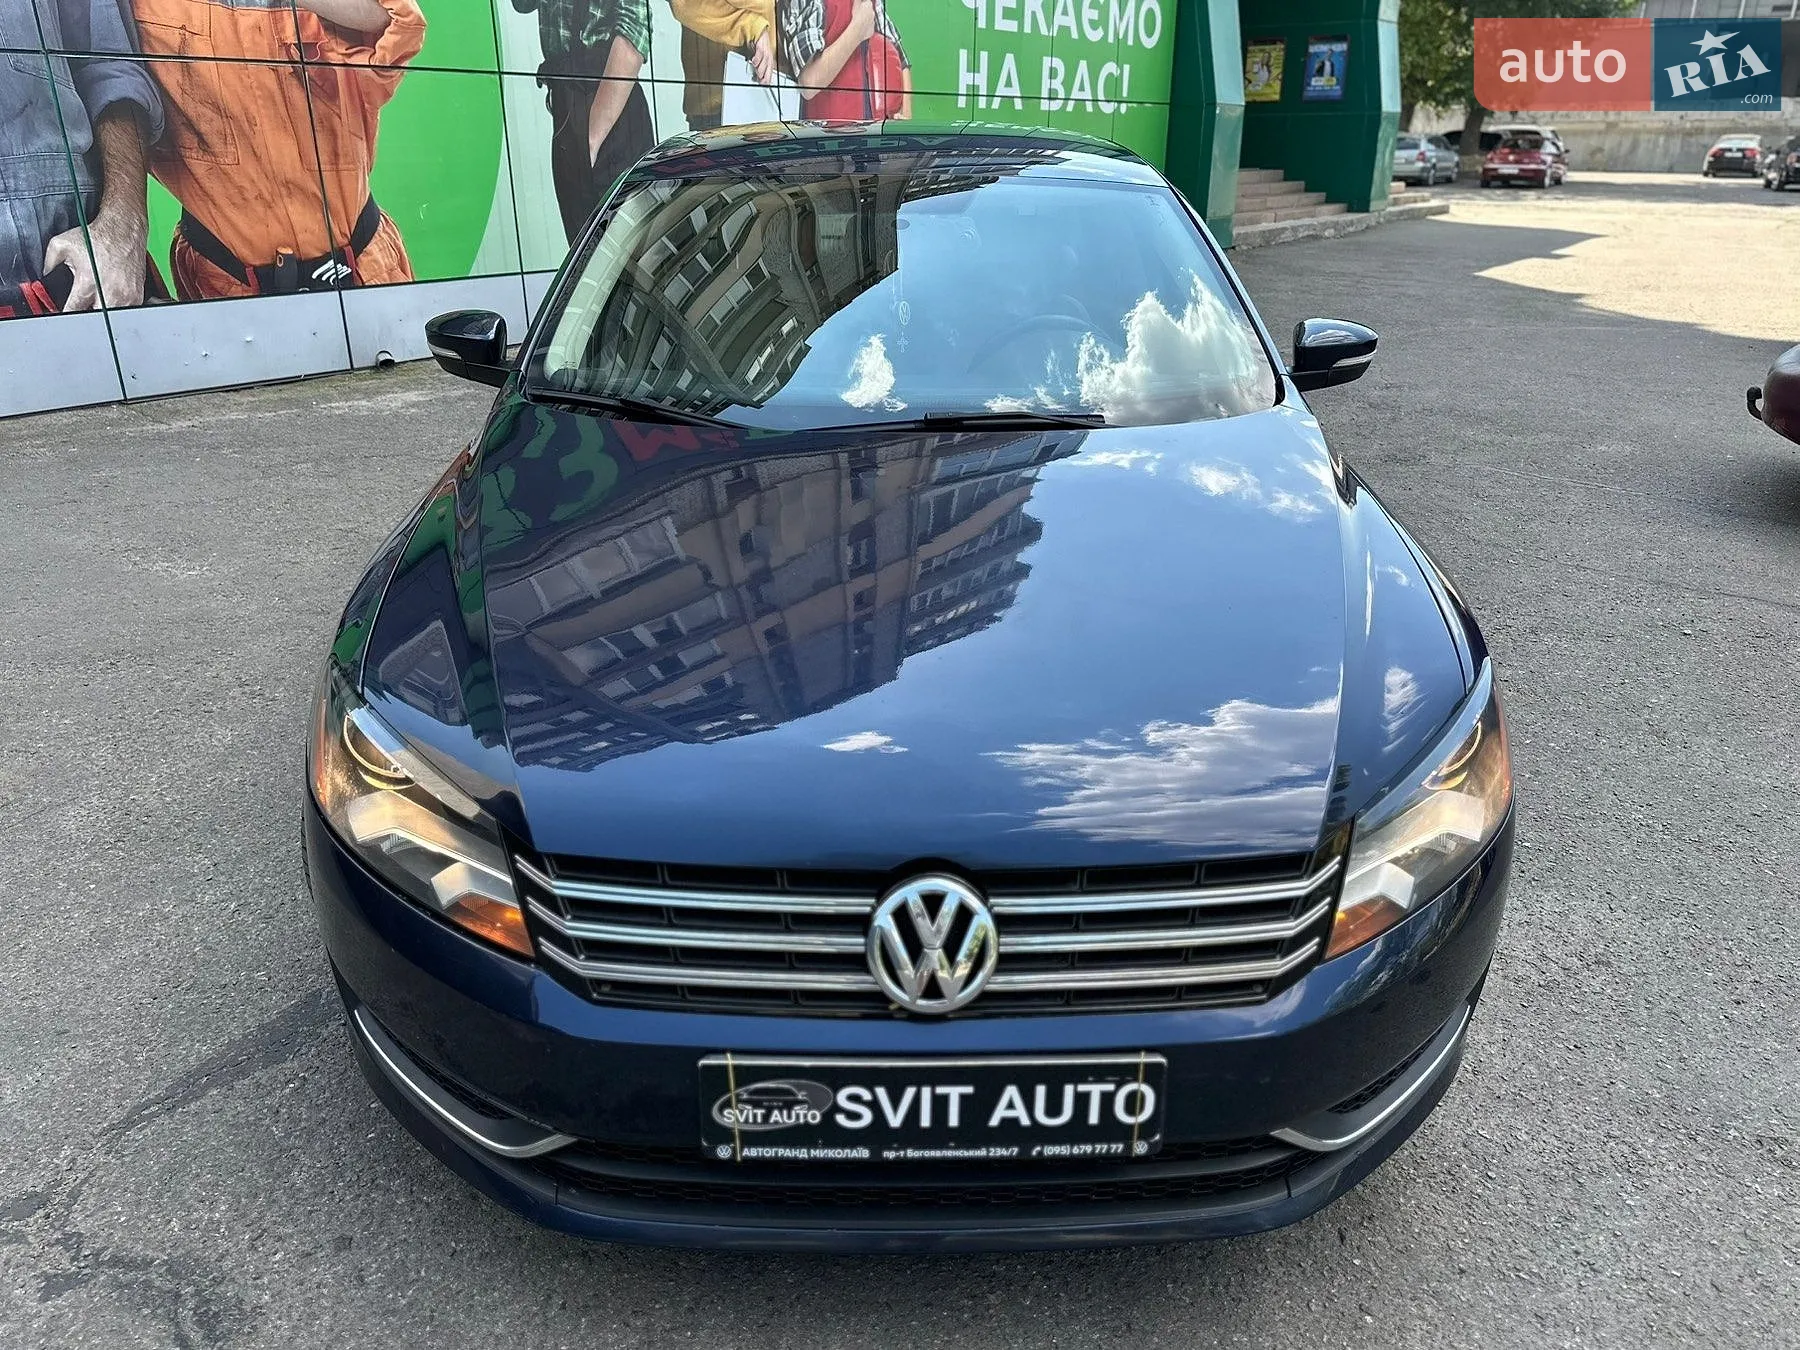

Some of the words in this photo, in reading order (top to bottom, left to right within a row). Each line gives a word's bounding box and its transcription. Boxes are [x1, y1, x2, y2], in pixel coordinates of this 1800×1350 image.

[957, 49, 1023, 110] НА
[1040, 56, 1130, 114] ВАС!
[835, 1086, 974, 1128] SVIT
[988, 1083, 1156, 1126] AUTO
[723, 1109, 765, 1123] SVIT
[769, 1109, 821, 1124] AUTO
[742, 1147, 808, 1159] АВТОГРАНД
[811, 1147, 870, 1158] МИКОЛАЇВ
[883, 1150, 905, 1159] пр-т
[988, 1147, 1019, 1157] 234/7
[1043, 1145, 1070, 1156] (095)
[1072, 1145, 1093, 1154] 679
[1094, 1144, 1108, 1153] 77
[1110, 1144, 1124, 1153] 77
